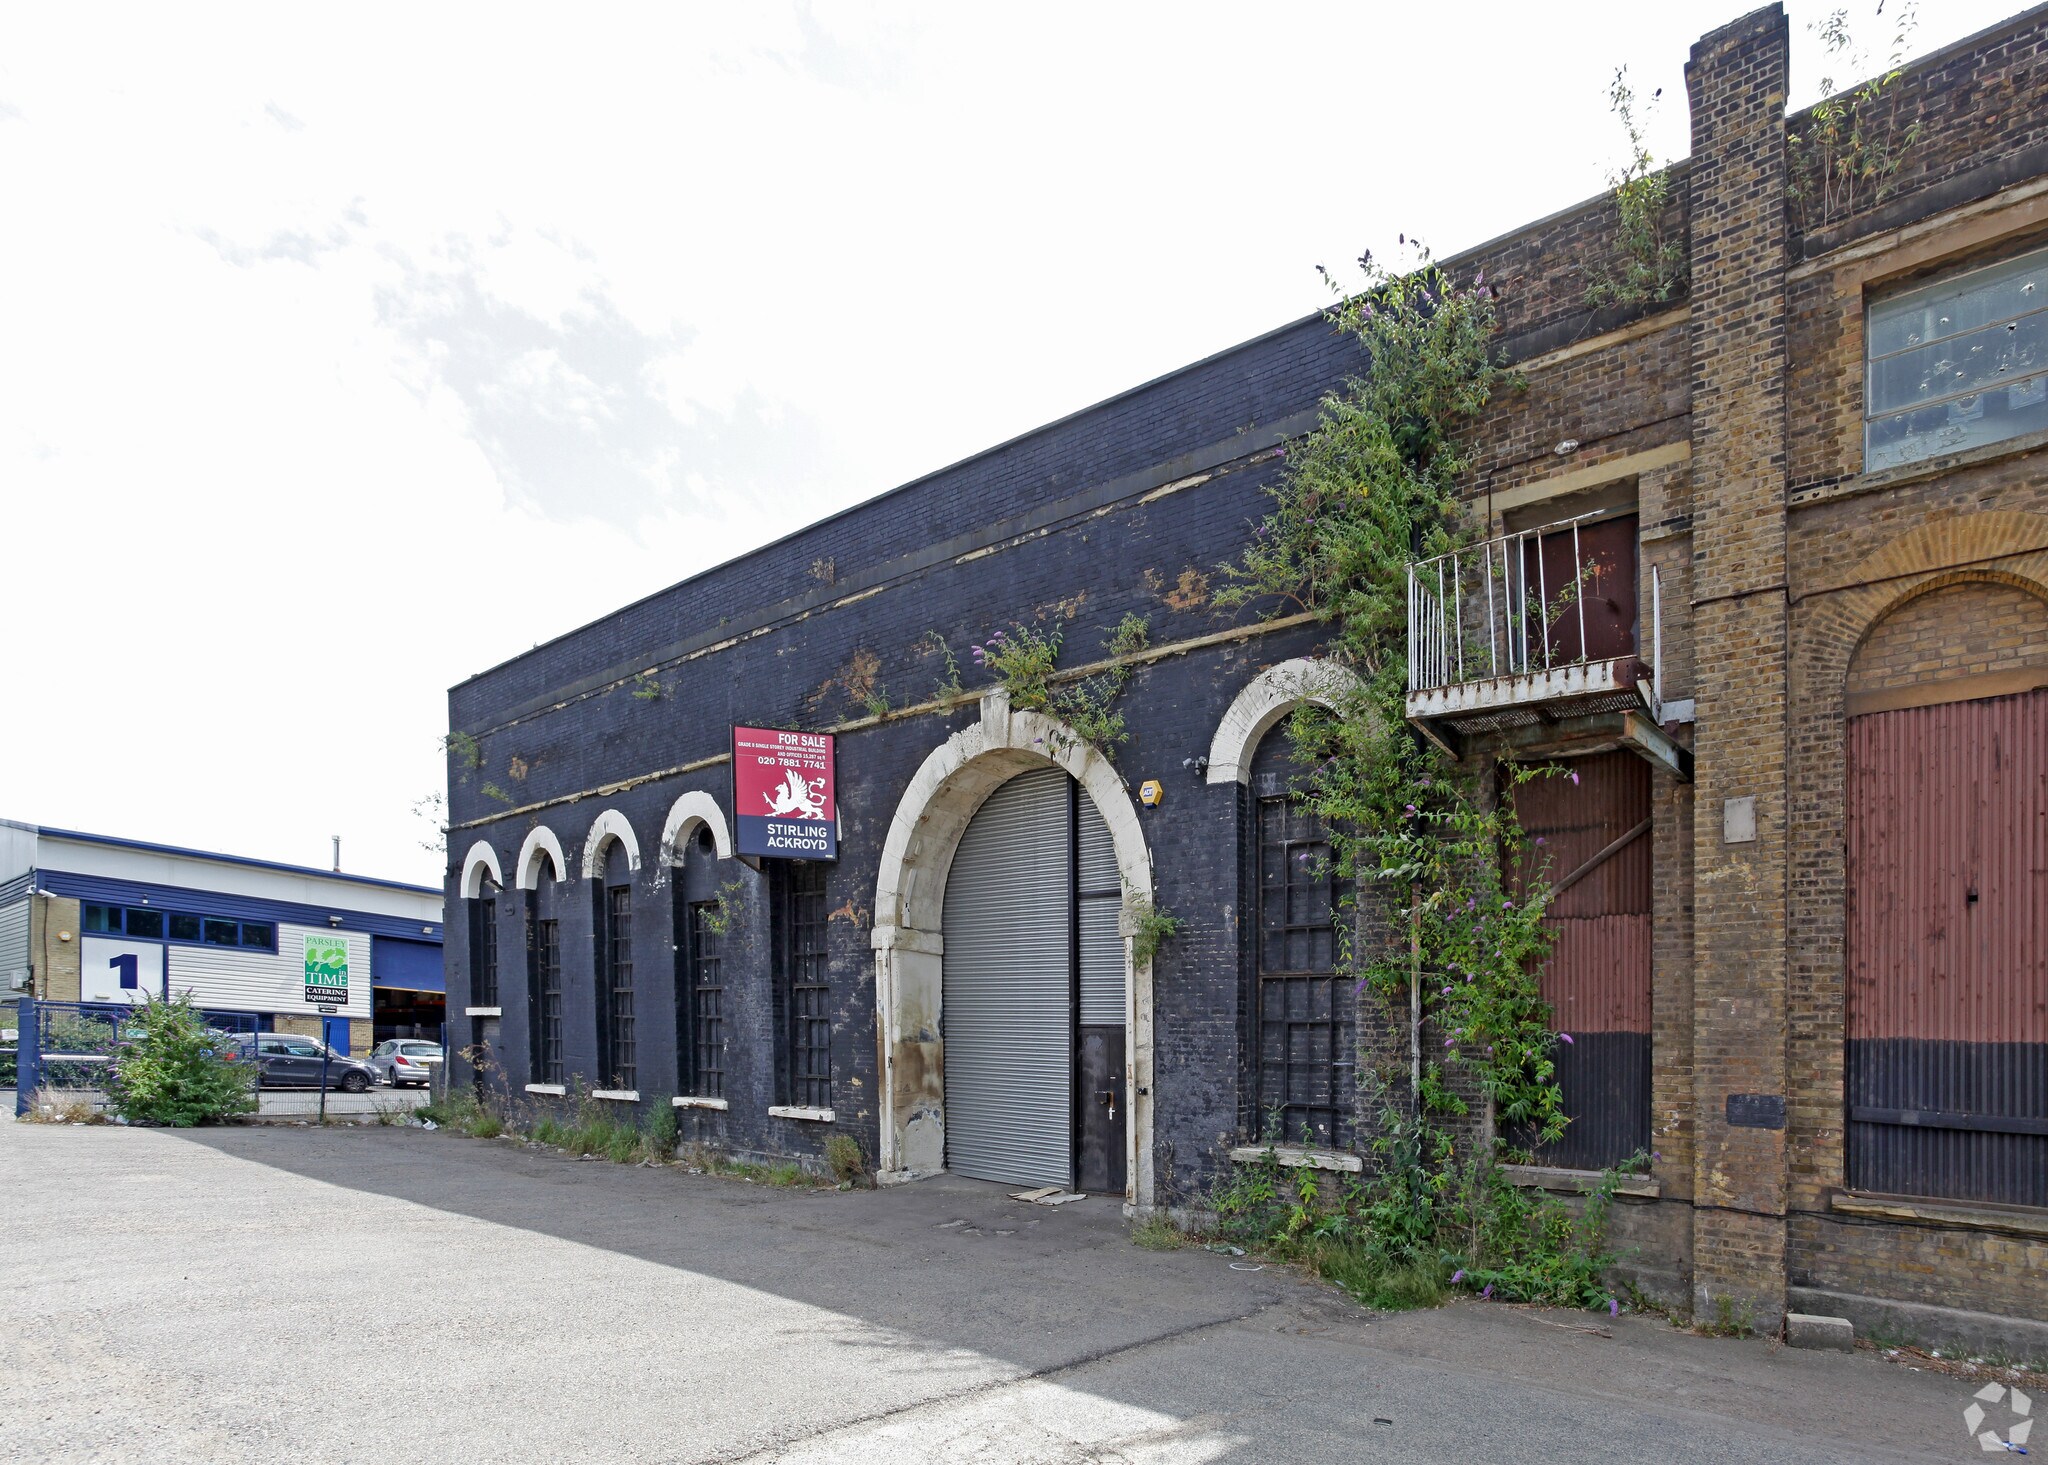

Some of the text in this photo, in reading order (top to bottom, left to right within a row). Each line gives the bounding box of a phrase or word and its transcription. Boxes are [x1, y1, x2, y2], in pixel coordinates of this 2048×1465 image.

[778, 734, 826, 748] FOR SALE
[758, 757, 826, 769] 020 7881 7741
[768, 824, 826, 838] STIRLING
[767, 837, 827, 850] ACKROYD
[306, 937, 346, 947] PARSLEY
[110, 954, 138, 989] 1
[306, 972, 347, 986] TIME
[306, 988, 346, 996] CATERING
